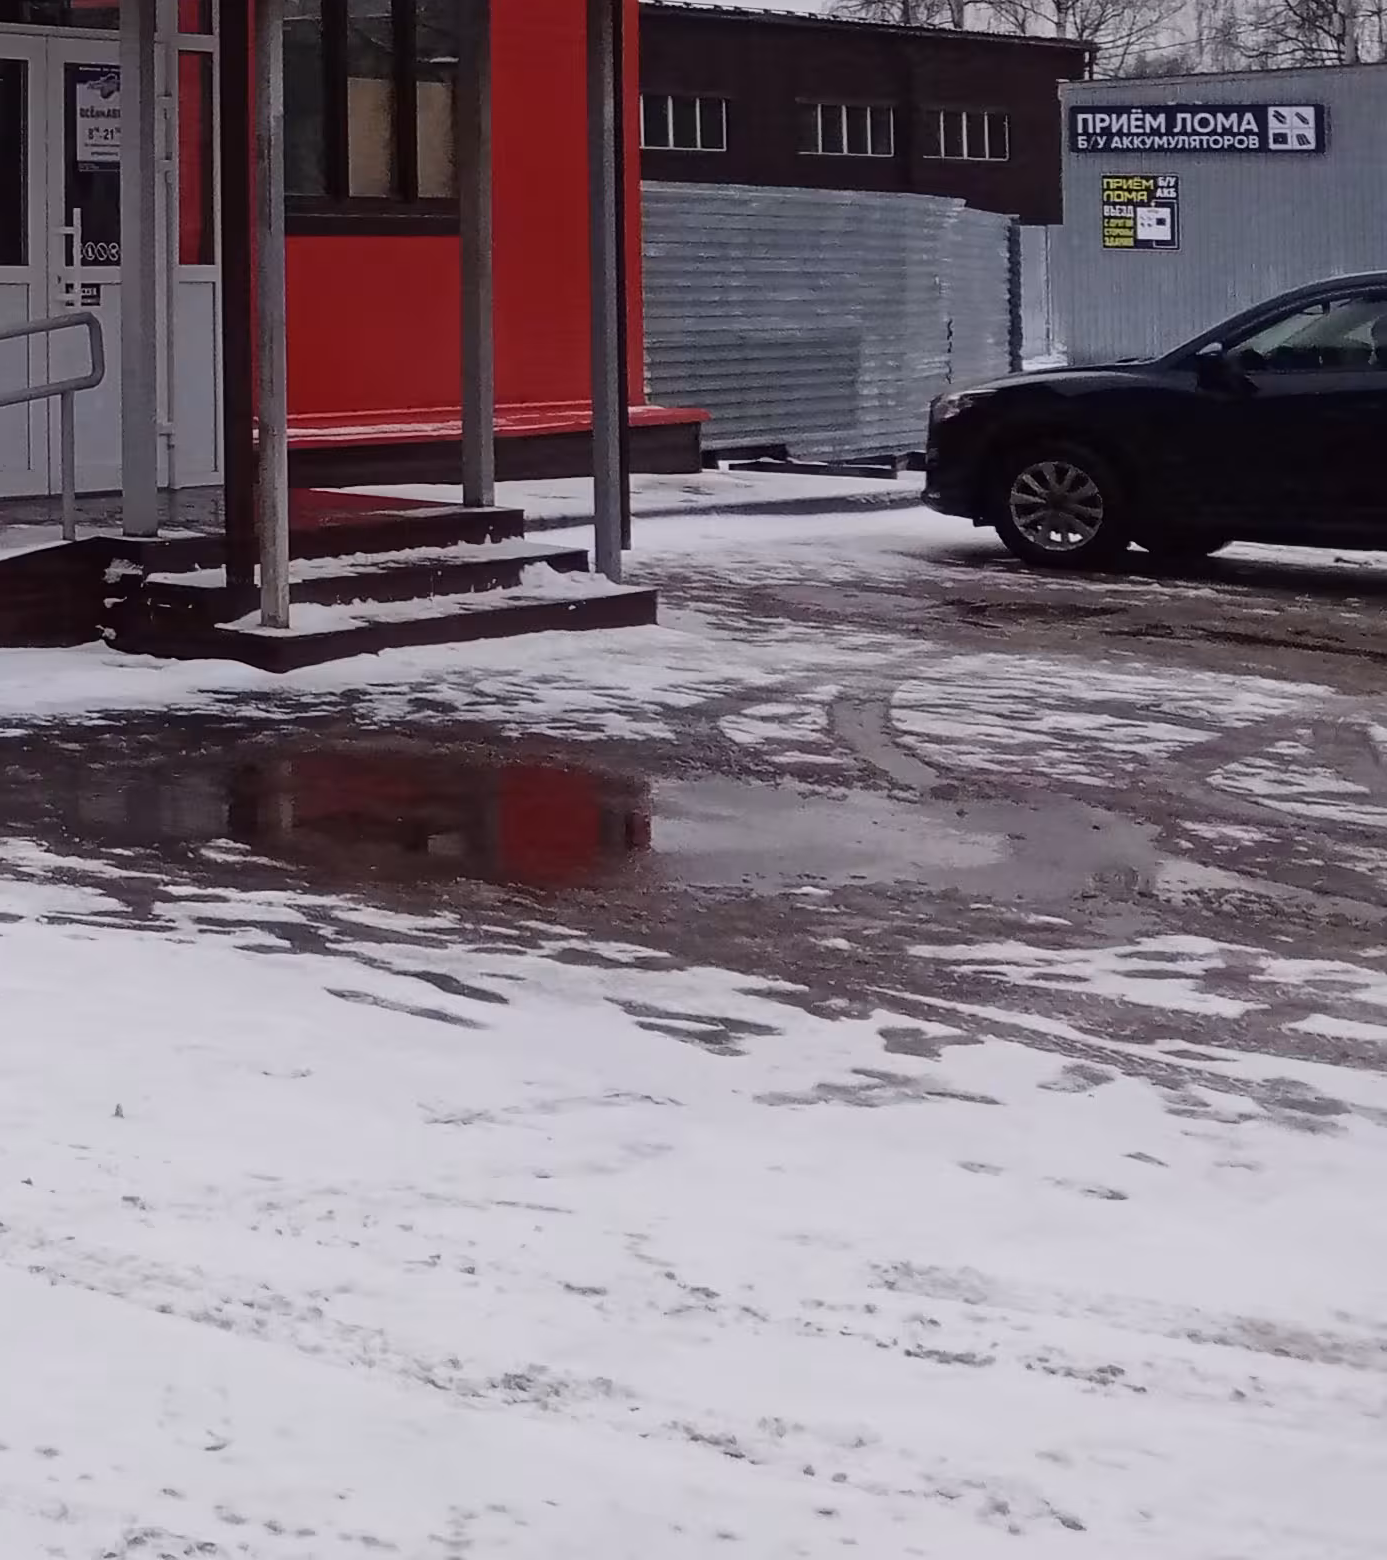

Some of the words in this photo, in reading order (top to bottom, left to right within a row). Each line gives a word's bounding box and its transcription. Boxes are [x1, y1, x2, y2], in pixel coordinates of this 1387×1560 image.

[1077, 108, 1166, 134] ПРИЁМ
[1172, 112, 1259, 133] ЛОМА
[1077, 135, 1108, 149] Б/У
[1110, 135, 1260, 149] АККУМУЛЯТОРОВ
[1103, 176, 1154, 190] ПРИЁМ
[1103, 190, 1148, 202] ЛОМА
[1155, 188, 1177, 198] АКБ
